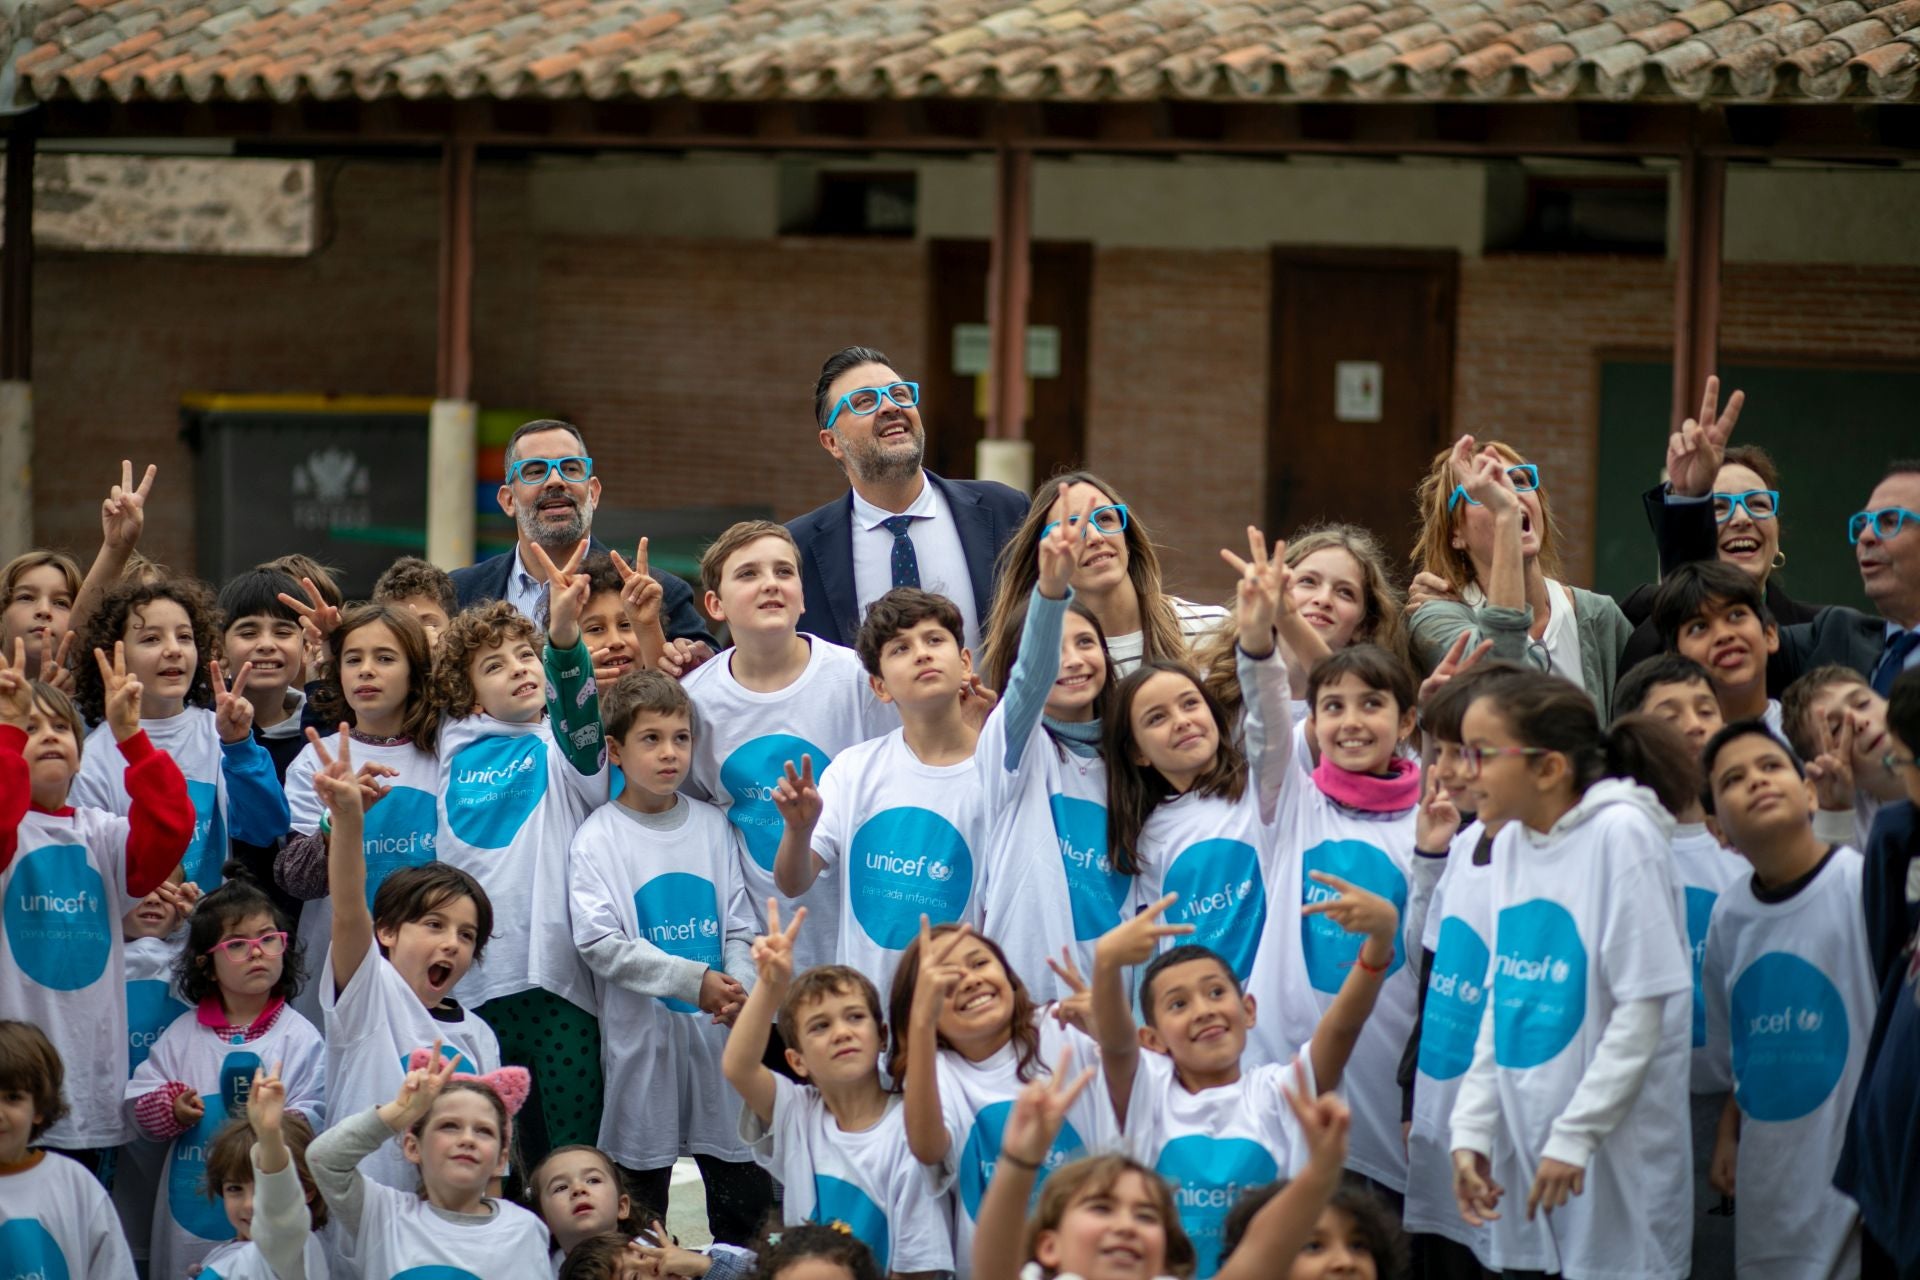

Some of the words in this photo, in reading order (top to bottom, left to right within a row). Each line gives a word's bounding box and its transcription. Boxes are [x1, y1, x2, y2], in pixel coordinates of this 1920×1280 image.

[738, 781, 782, 801] unic
[362, 831, 417, 855] nicef
[866, 850, 927, 877] unicef
[20, 890, 87, 914] unicef
[905, 890, 947, 909] infancia
[1182, 883, 1233, 919] nicef
[1495, 950, 1552, 981] nicef
[130, 1025, 165, 1048] cef
[177, 1141, 209, 1161] uni
[1173, 1181, 1236, 1207] nicef
